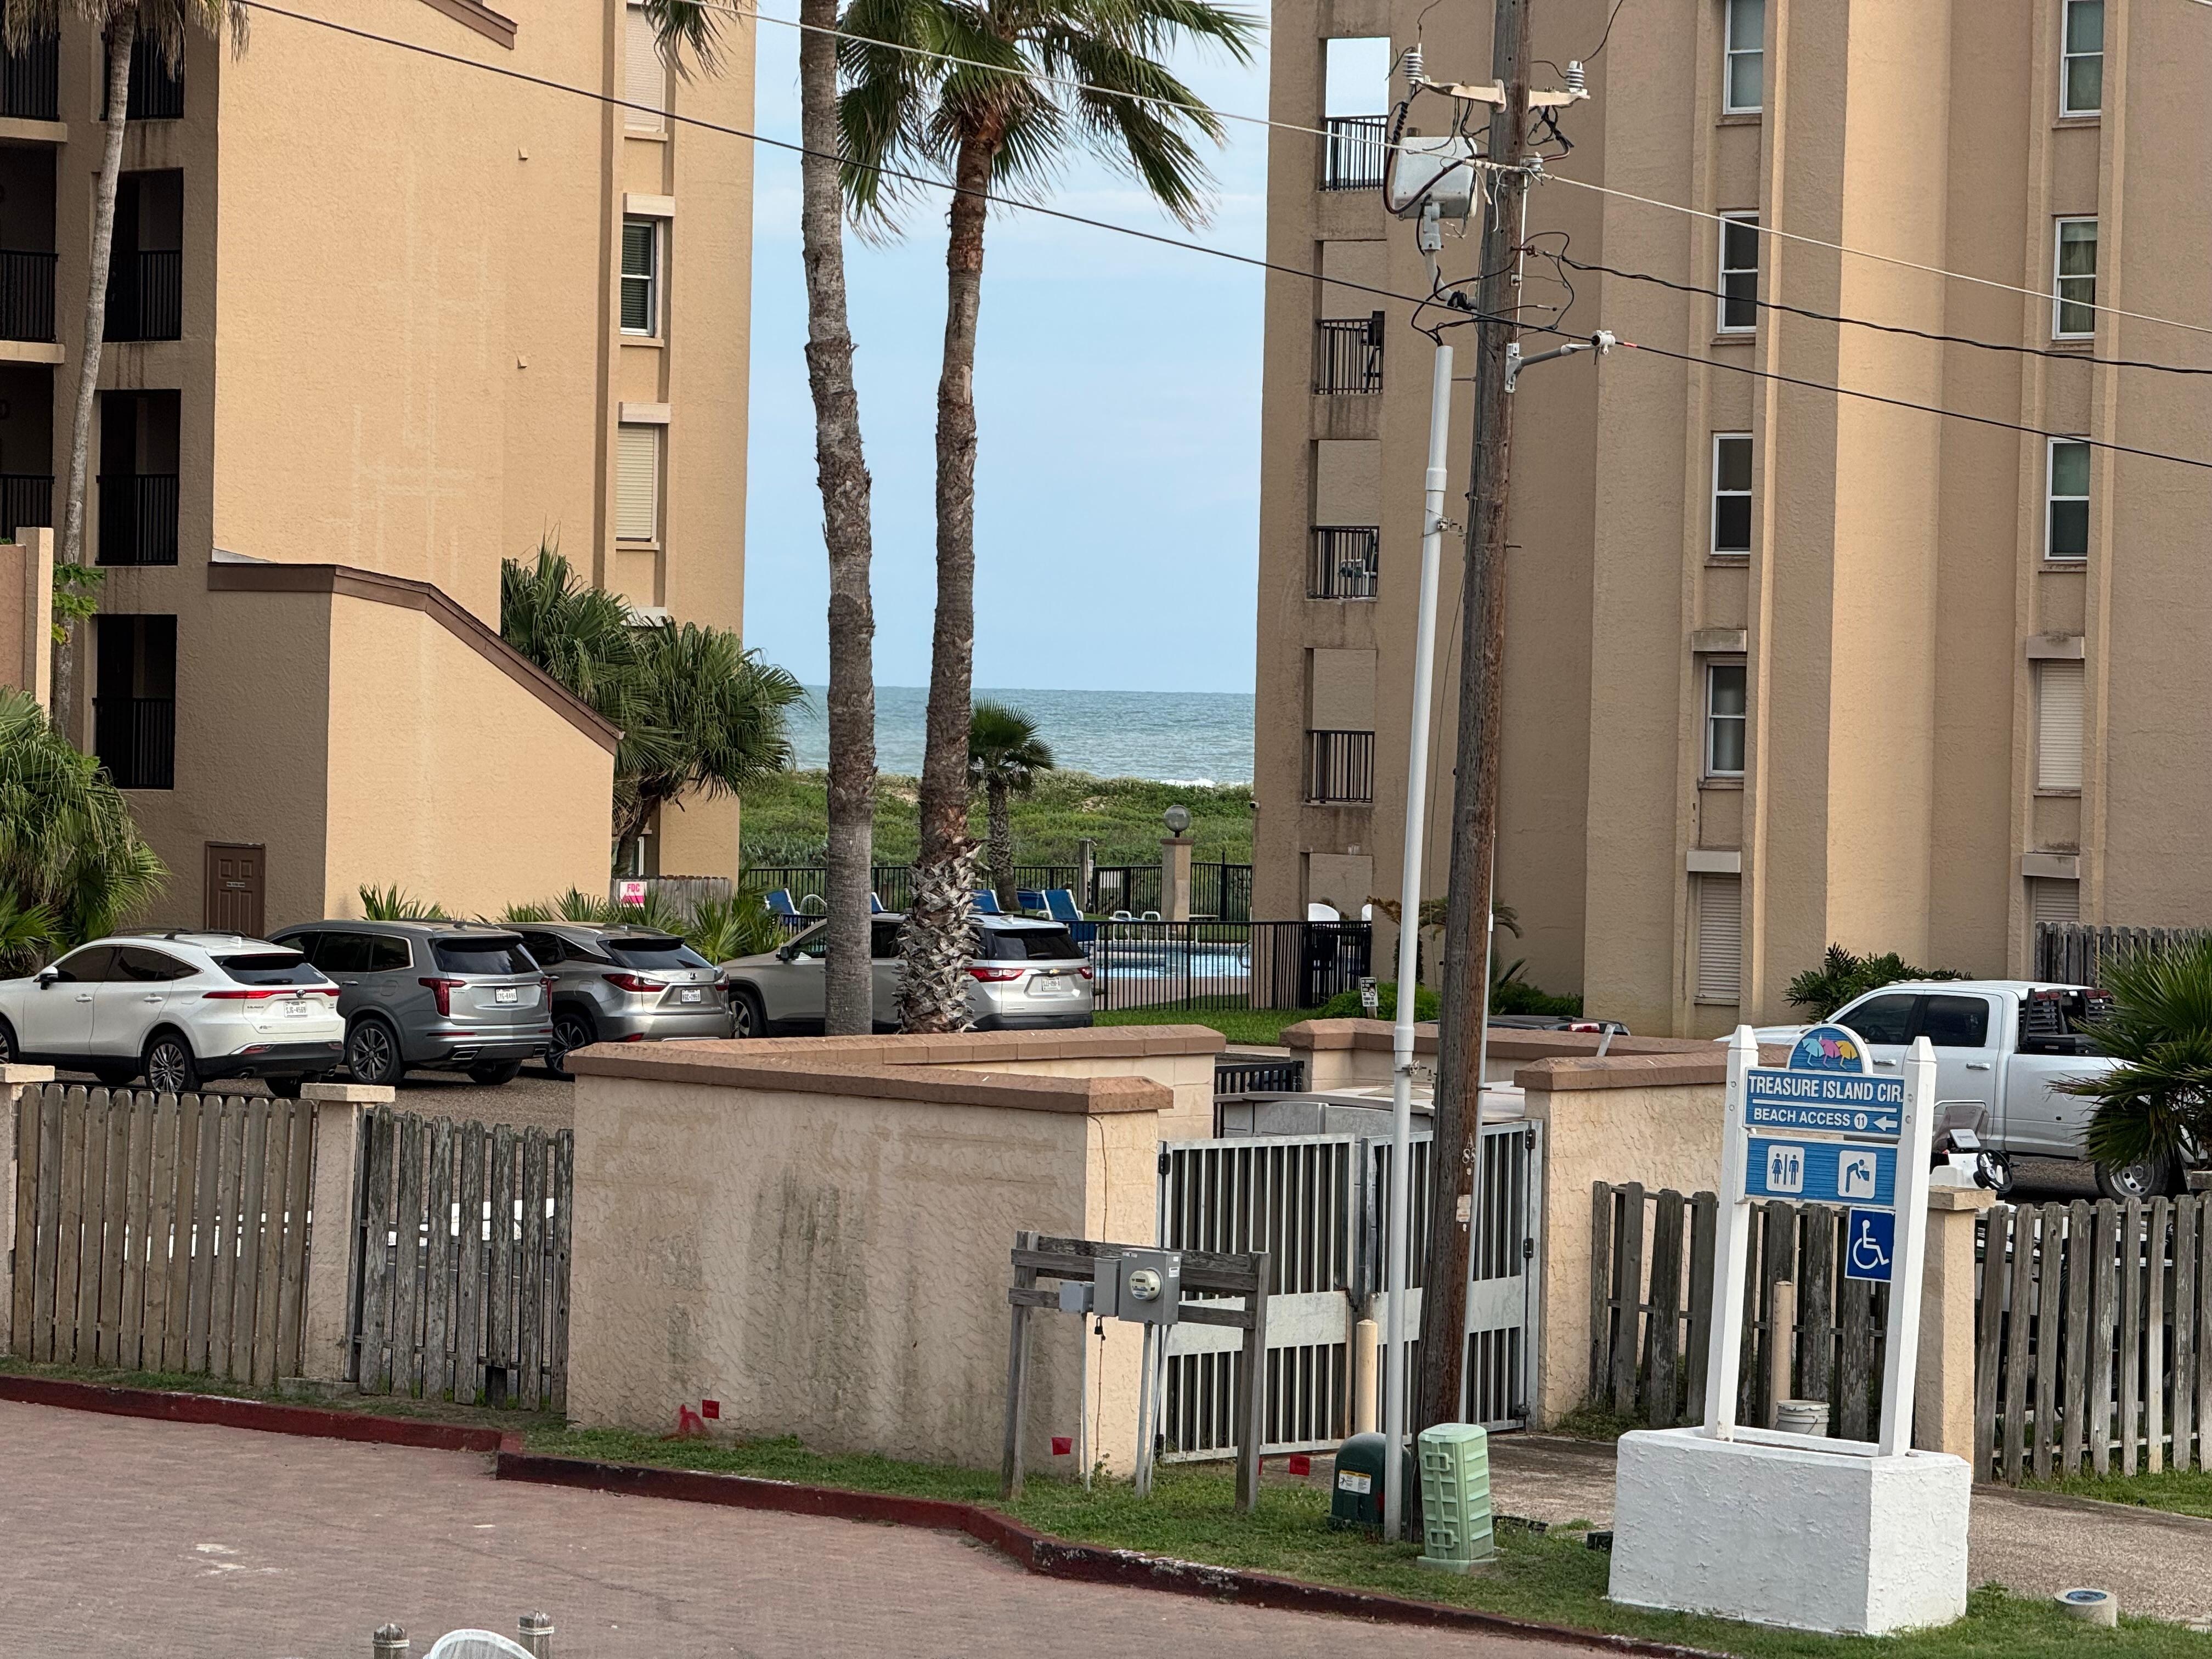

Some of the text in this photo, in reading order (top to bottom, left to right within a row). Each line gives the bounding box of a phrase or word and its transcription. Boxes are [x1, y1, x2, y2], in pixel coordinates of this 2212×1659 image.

[627, 883, 640, 892] FDC
[1748, 1076, 1904, 1103] TREASURE ISLAND CIR.
[1754, 1108, 1865, 1126] BEACH ACCESS 11
